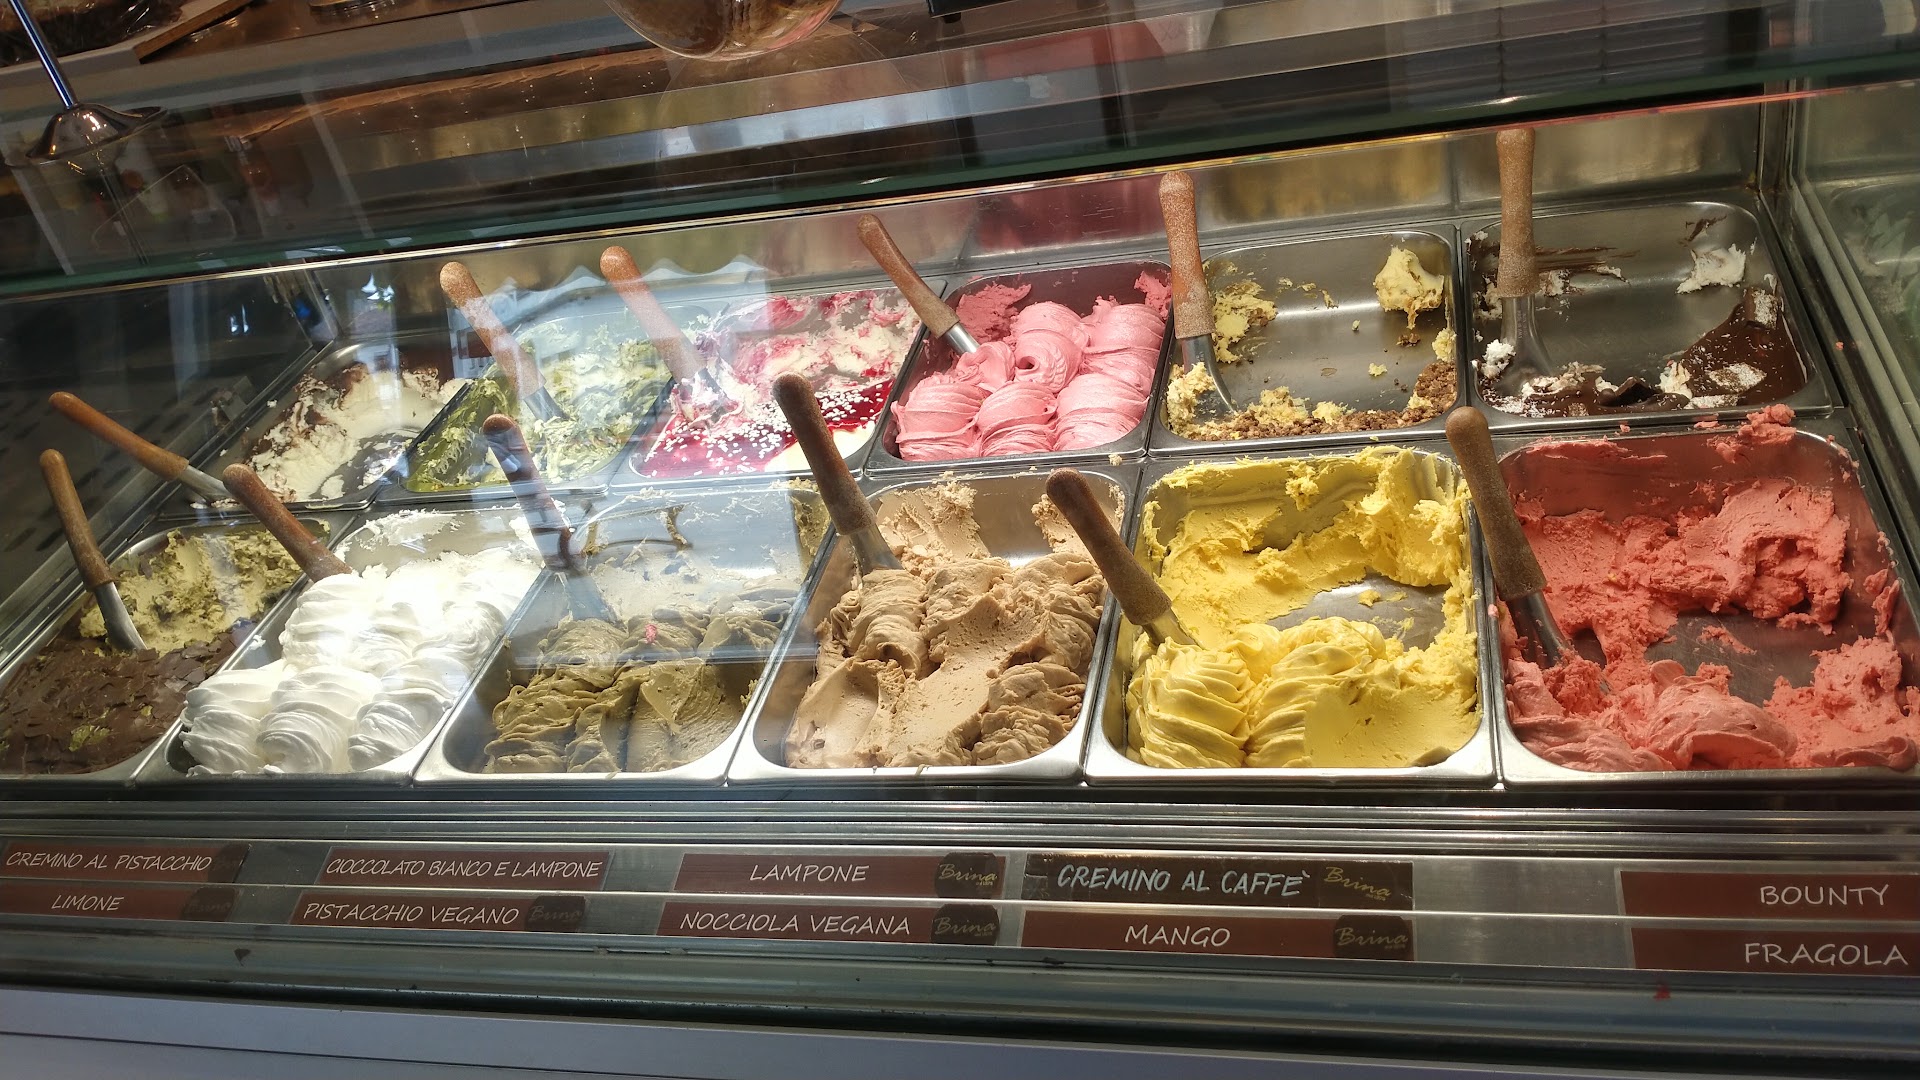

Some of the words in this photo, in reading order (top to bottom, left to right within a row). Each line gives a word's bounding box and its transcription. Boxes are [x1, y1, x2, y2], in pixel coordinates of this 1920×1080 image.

[6, 851, 84, 869] CREMINO
[85, 852, 108, 869] AL
[114, 854, 212, 872] PISTACCHIO
[326, 858, 426, 876] CIOCCOLATO
[428, 860, 492, 878] BIANCO
[494, 861, 510, 877] E
[511, 861, 602, 879] LAMPONE
[938, 863, 998, 881] Brina
[750, 864, 870, 882] LAMPONE
[1057, 864, 1171, 894] CREMINO
[1181, 870, 1210, 893] AL
[1323, 866, 1392, 897] Brina
[51, 895, 125, 912] LIMONE
[1760, 884, 1889, 906] BOUNTY
[303, 903, 424, 923] PISTACCHIO
[430, 906, 520, 925] VEGANO
[679, 912, 800, 933] NOCCIOLA
[809, 915, 911, 935] VEGANA
[1124, 924, 1231, 948] MANGO
[1744, 942, 1909, 966] FRAGOLA
